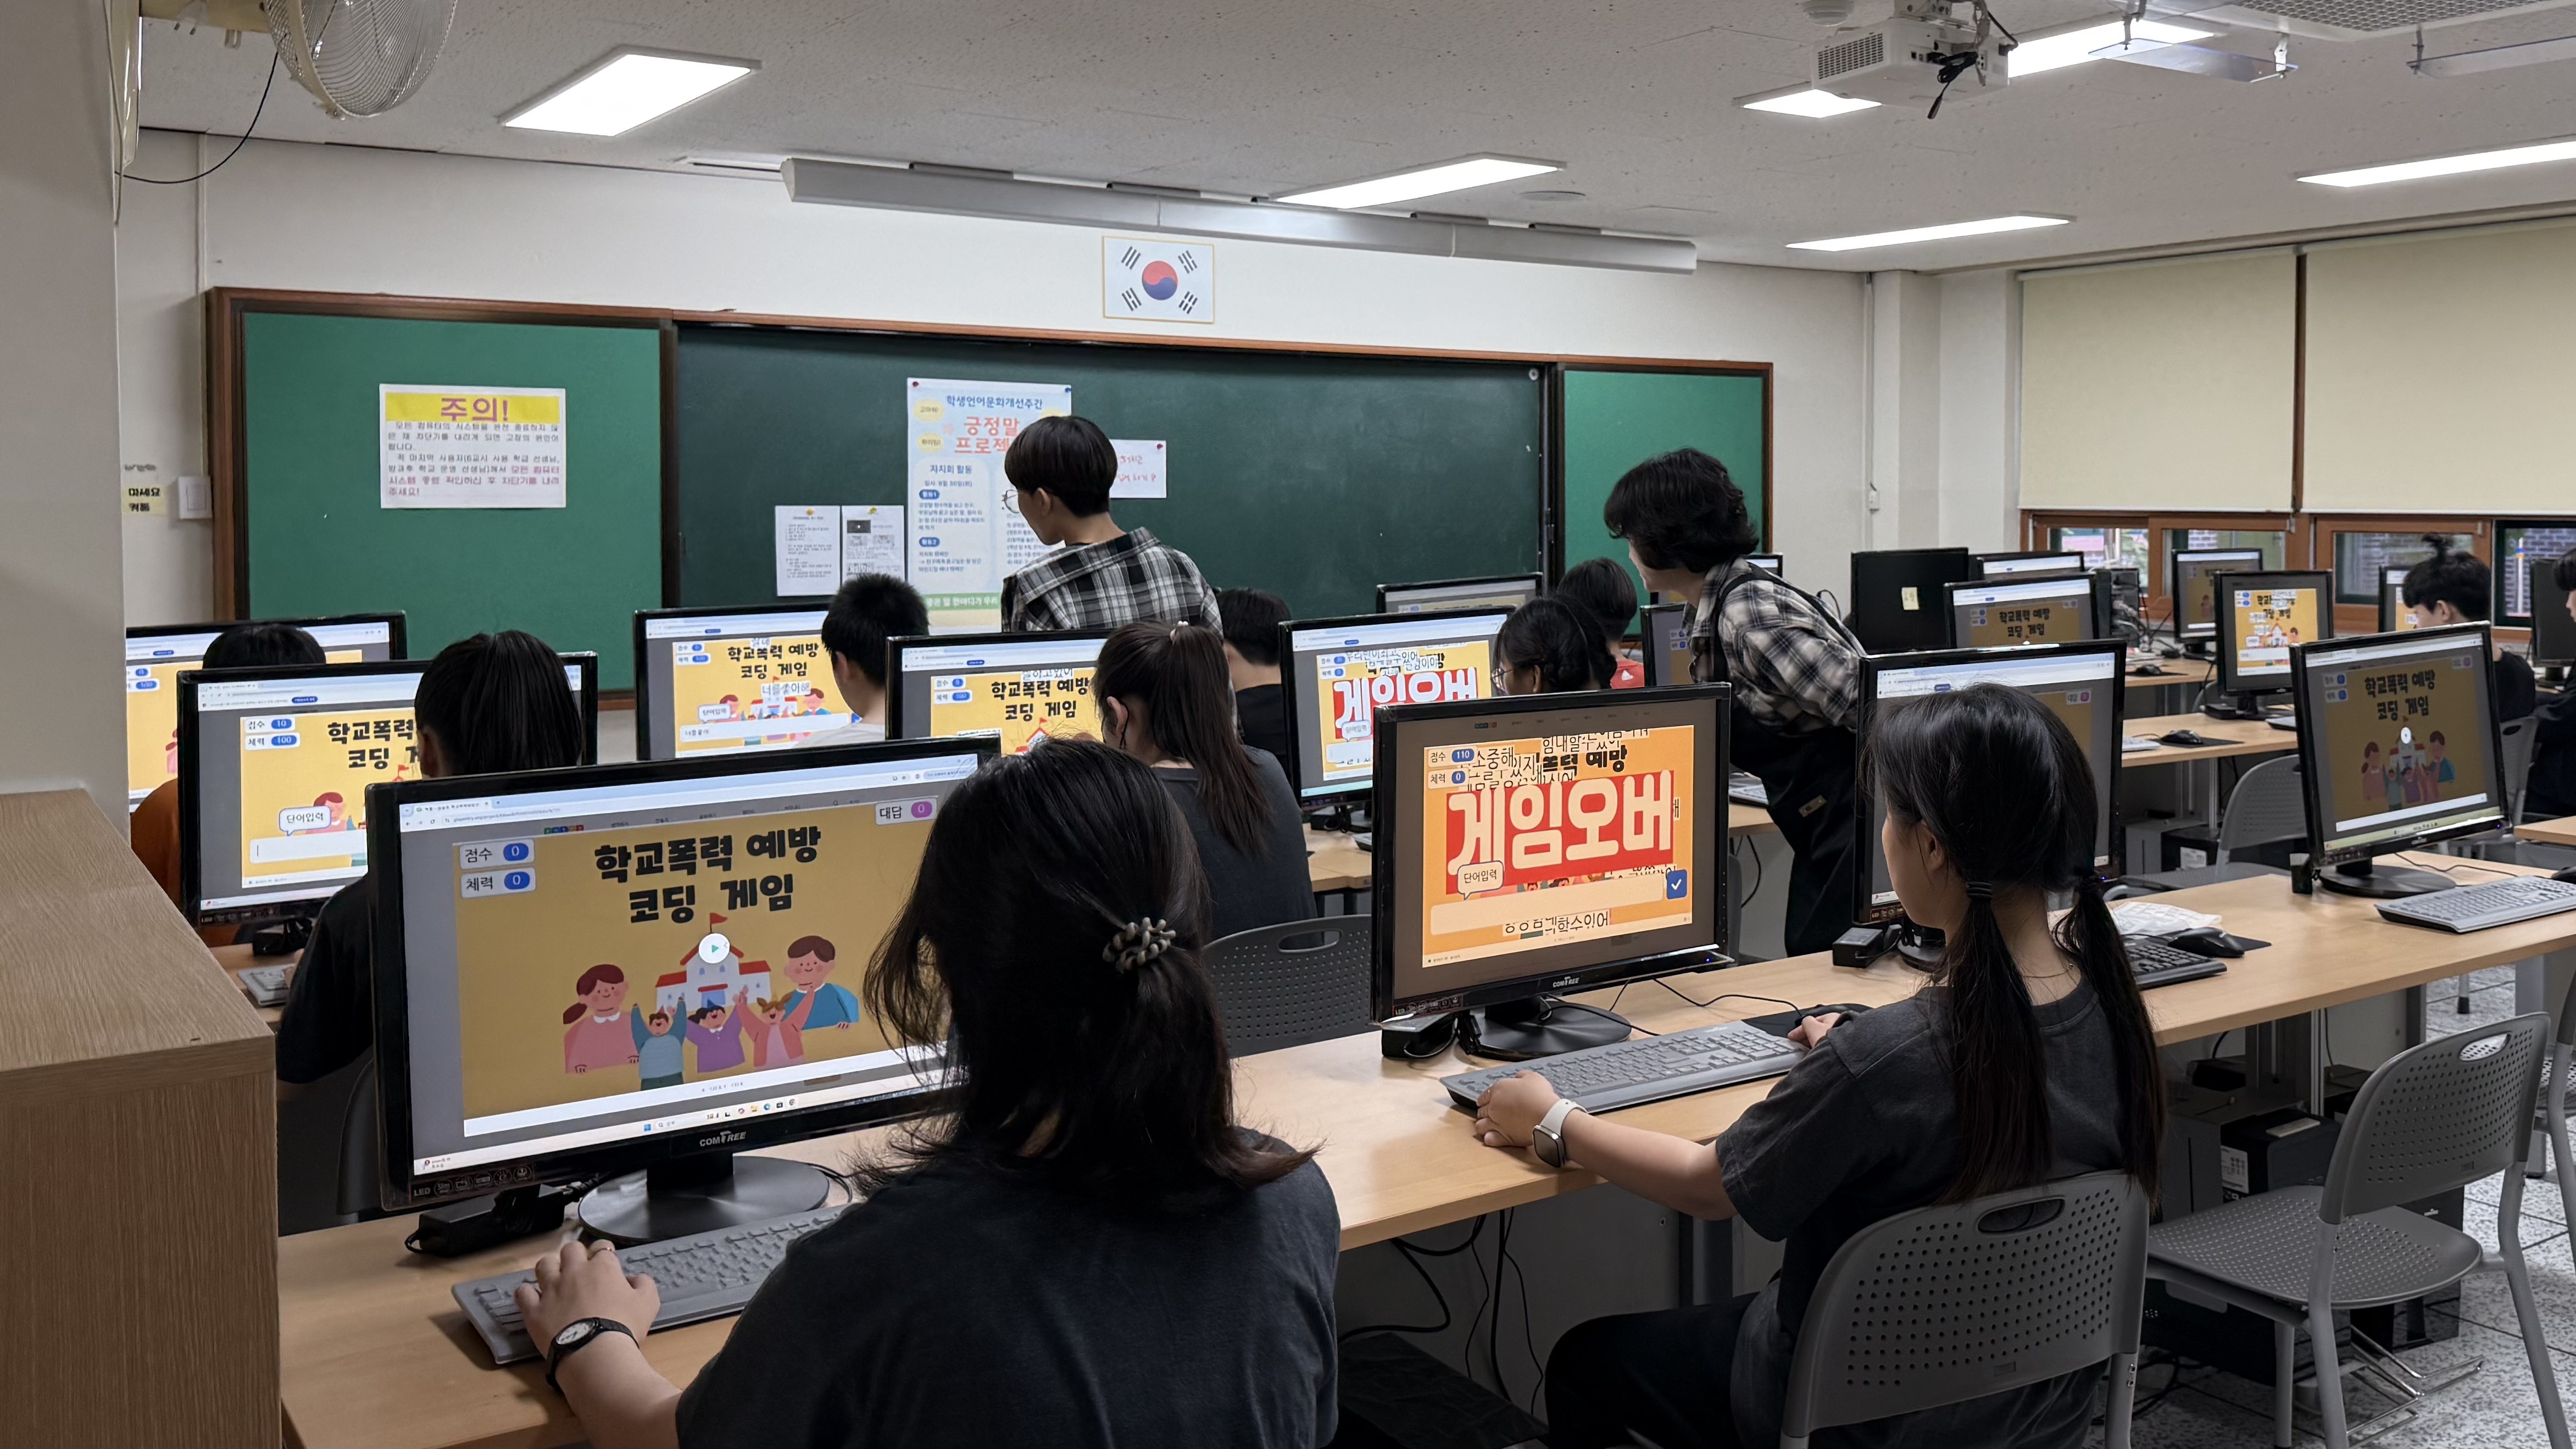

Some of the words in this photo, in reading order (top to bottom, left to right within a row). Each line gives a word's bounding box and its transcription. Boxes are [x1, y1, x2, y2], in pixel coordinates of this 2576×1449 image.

[441, 397, 508, 422] 주의!
[947, 395, 1043, 410] 학생언어문화개선주간
[964, 416, 1020, 436] 긍정말
[954, 437, 1011, 454] 프로젝
[788, 642, 819, 658] 예방
[741, 664, 767, 680] 코딩
[777, 662, 808, 677] 게임
[991, 680, 1051, 700] 학교폭력
[1057, 677, 1090, 695] 예방
[2364, 673, 2408, 698] 학교폭력
[2412, 669, 2435, 690] 예방
[1005, 703, 1034, 721] 코딩
[1045, 700, 1077, 718] 게임
[2377, 700, 2398, 721] 코딩
[2405, 696, 2429, 717] 게임
[277, 736, 292, 744] 100
[327, 719, 414, 745] 학교폭력
[348, 747, 390, 770] 코딩
[1431, 752, 1446, 763] 점수
[1456, 750, 1470, 759] 110
[1430, 774, 1446, 784] 체력
[880, 806, 903, 820] 대답
[1447, 769, 1672, 875] 게임오버
[465, 847, 493, 863] 점수
[594, 835, 733, 884] 학교폭력
[746, 826, 821, 863] 예방
[466, 876, 494, 891] 체력
[1464, 868, 1498, 884] 단어입력
[629, 885, 696, 924] 코딩
[720, 874, 793, 912] 게임
[1553, 975, 1580, 989] COMTREE
[699, 1129, 747, 1147] COMTREE
[414, 1187, 431, 1197] LED
